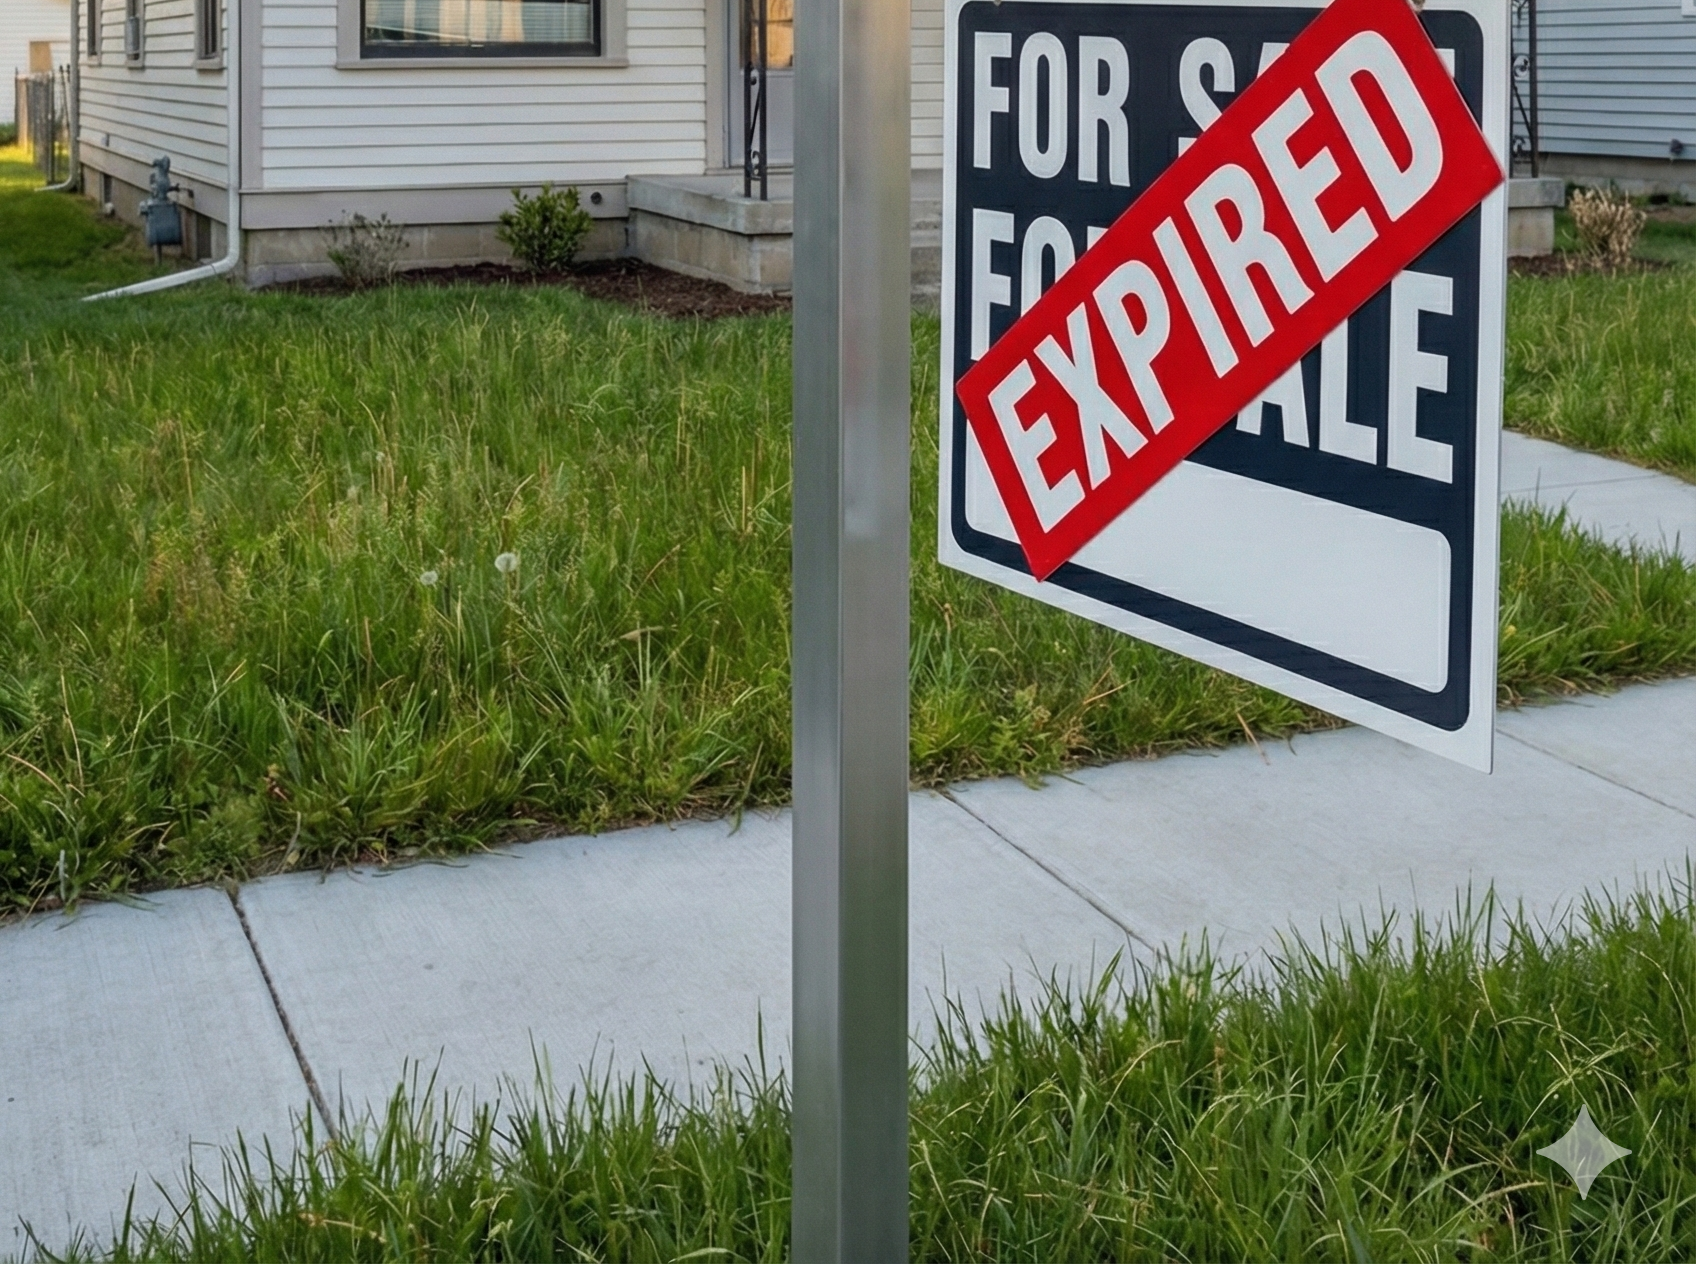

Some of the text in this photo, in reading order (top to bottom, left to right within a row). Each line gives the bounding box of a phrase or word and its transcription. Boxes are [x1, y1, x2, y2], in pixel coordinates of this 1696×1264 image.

[973, 31, 1131, 187] FOR
[970, 207, 1109, 362] FO
[987, 30, 1444, 534] EXPIRED
